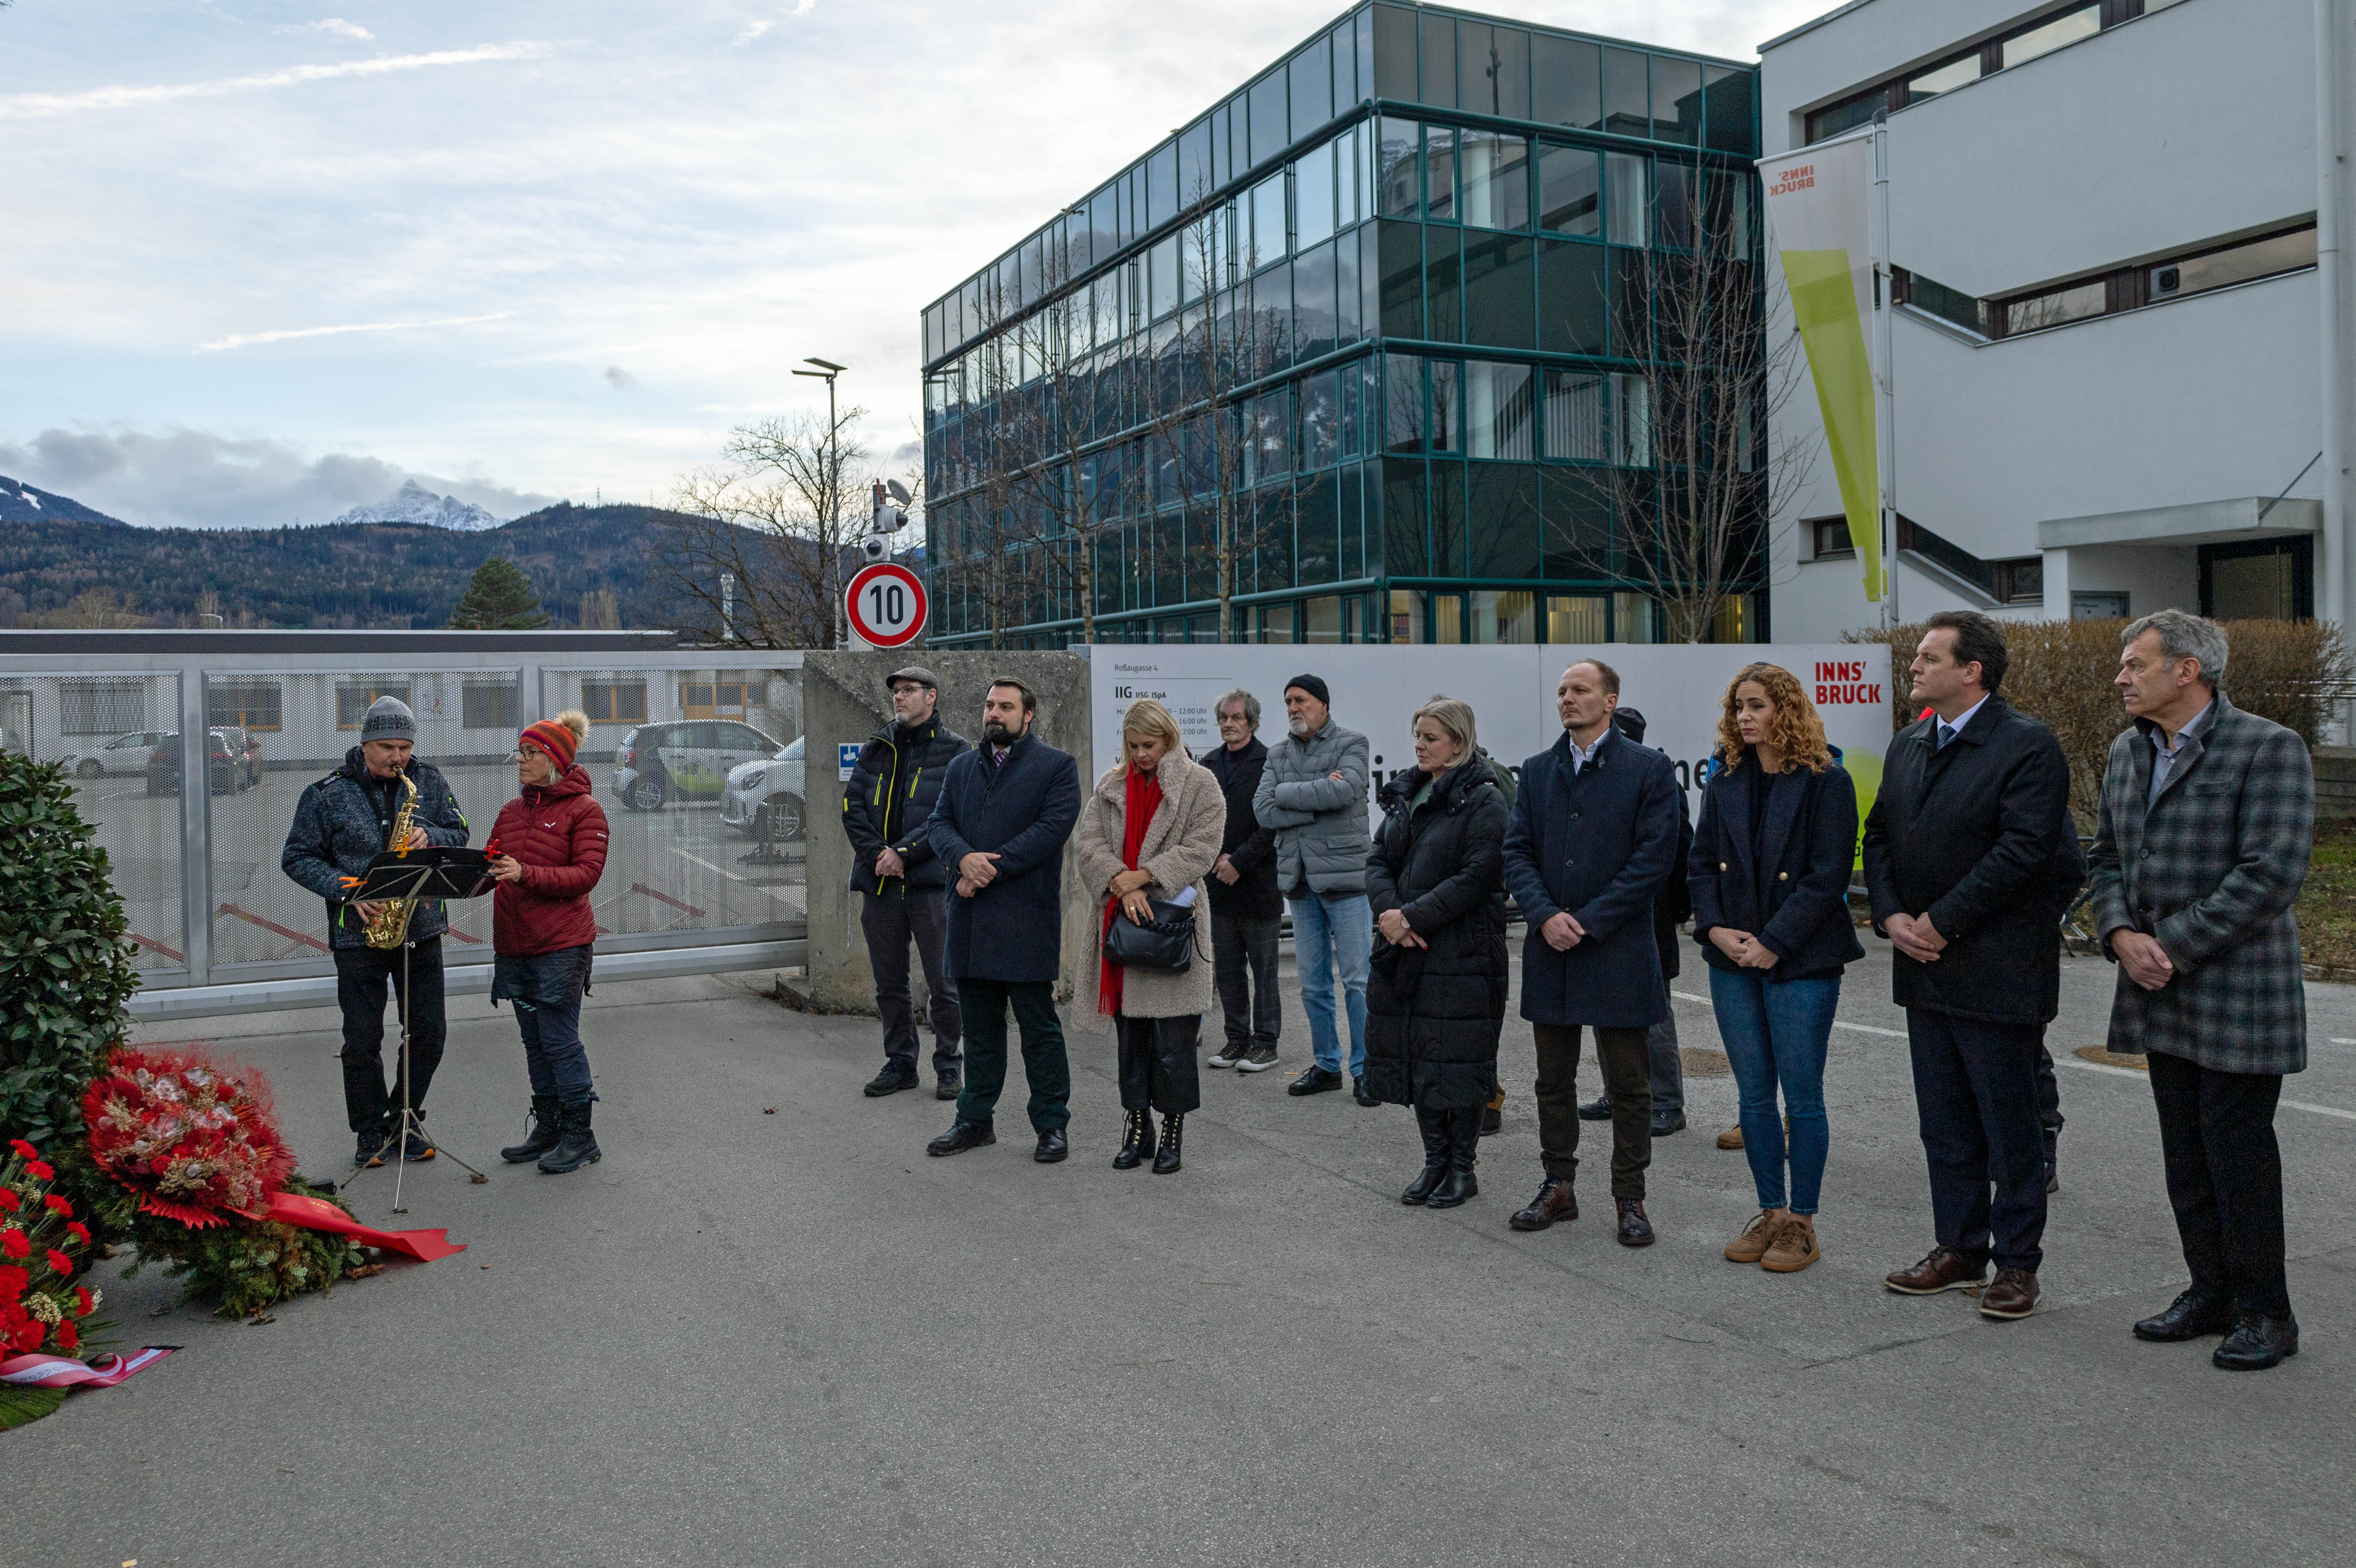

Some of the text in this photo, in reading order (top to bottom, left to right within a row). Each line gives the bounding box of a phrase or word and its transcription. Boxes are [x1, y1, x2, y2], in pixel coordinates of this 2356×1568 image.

[870, 585, 904, 625] 10
[1114, 664, 1152, 673] Roßaugasse
[1815, 661, 1866, 682] INNS'
[1115, 687, 1132, 698] IIG
[1816, 684, 1881, 704] BRUCK
